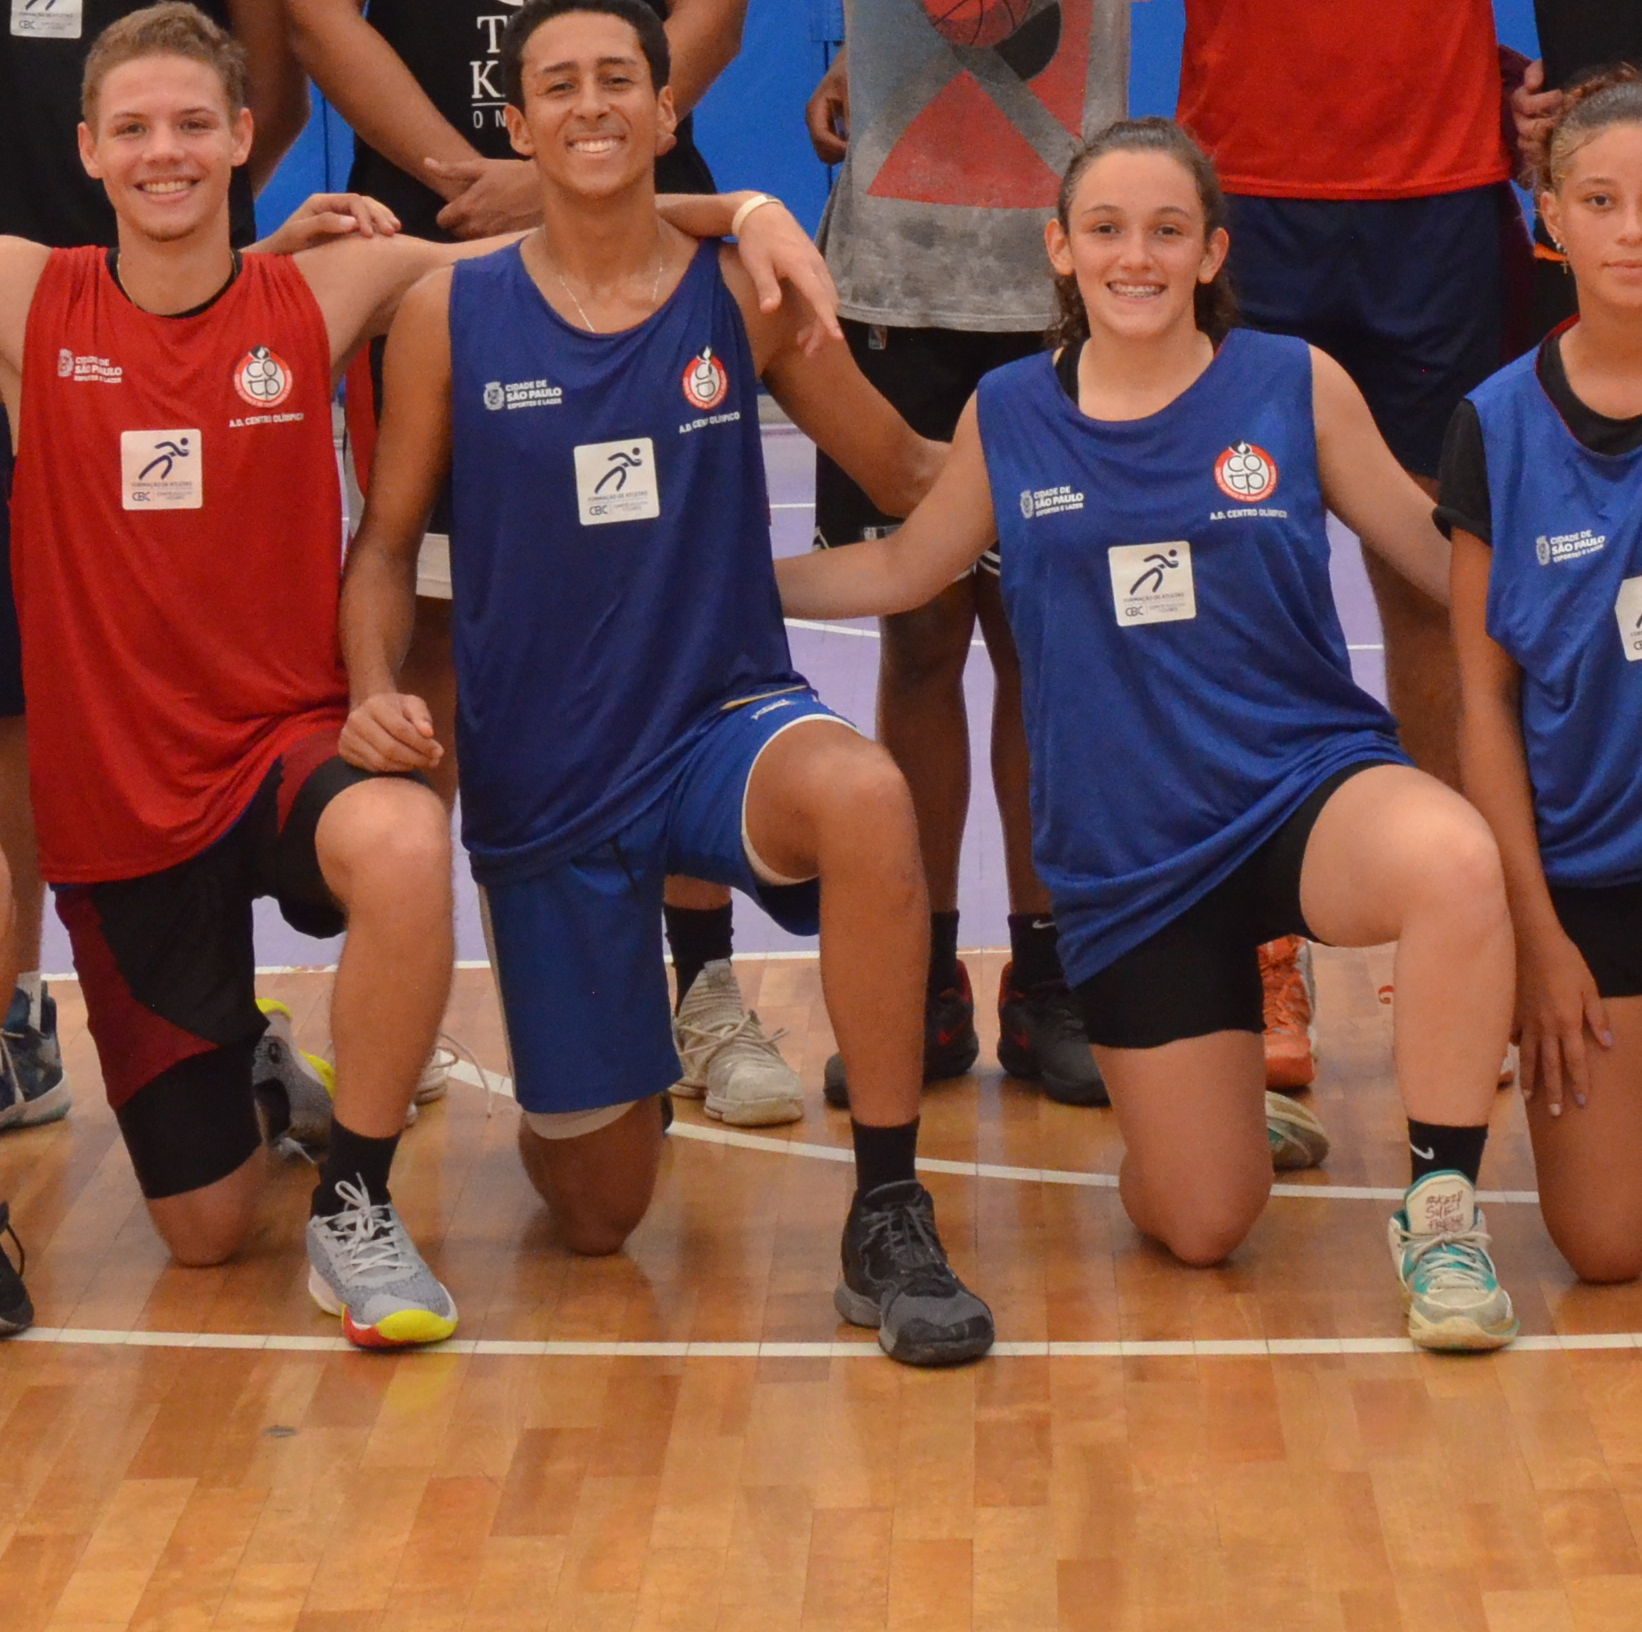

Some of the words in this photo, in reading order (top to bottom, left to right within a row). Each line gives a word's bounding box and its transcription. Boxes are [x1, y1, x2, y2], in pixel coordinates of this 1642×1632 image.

[505, 381, 534, 392] CIDADE
[536, 379, 547, 388] DE
[506, 389, 527, 402] SÃO
[528, 387, 562, 399] PAULO
[1033, 487, 1058, 499] CIDADE
[1059, 485, 1070, 494] DE
[1034, 498, 1052, 509] SÃO
[1052, 492, 1084, 505] PAULO
[1550, 533, 1579, 545] CIDADE
[1580, 529, 1592, 538] DE
[1551, 542, 1574, 555] SÃO
[1574, 535, 1605, 550] PAULO
